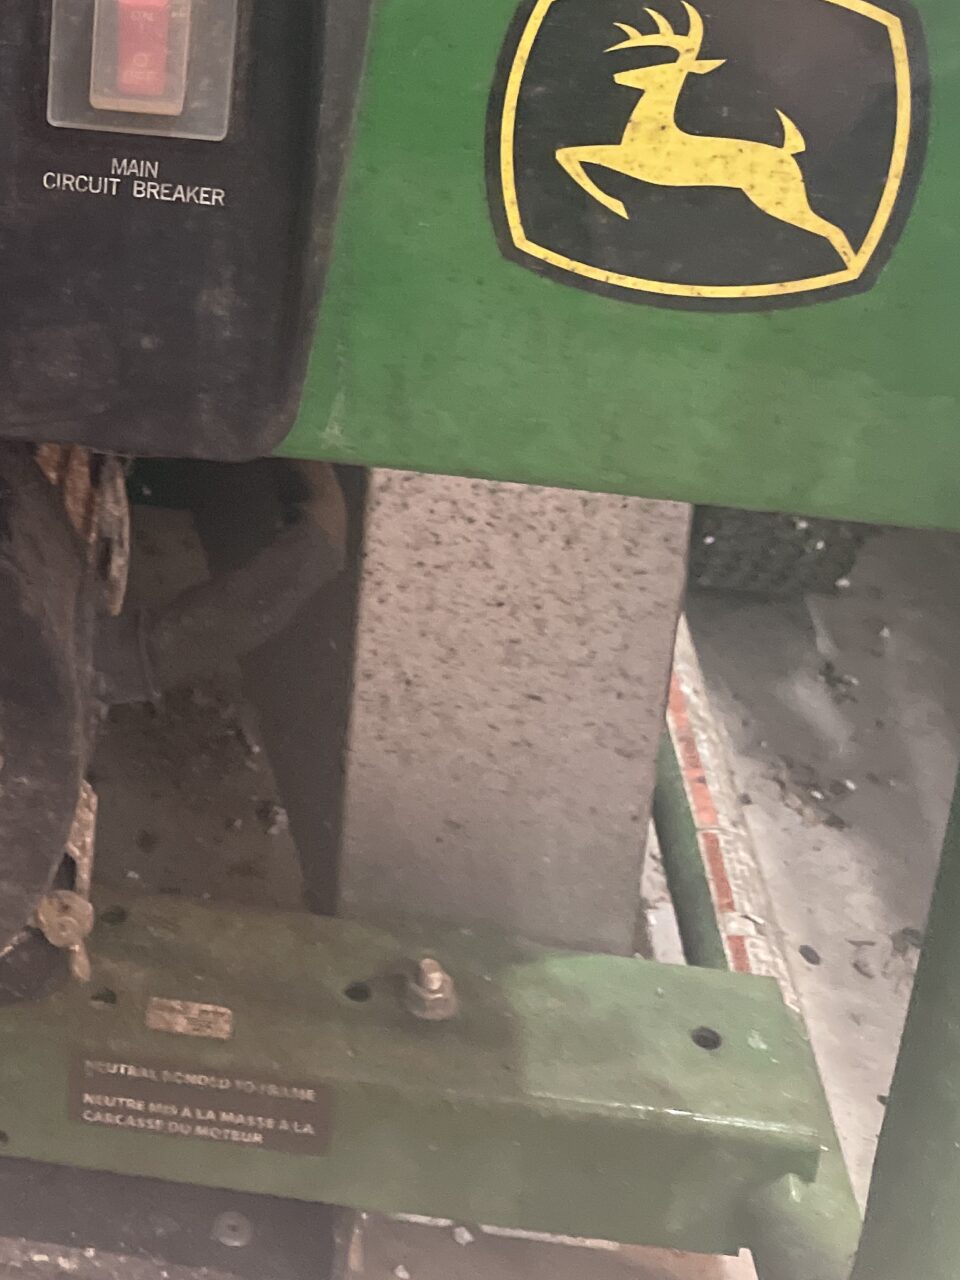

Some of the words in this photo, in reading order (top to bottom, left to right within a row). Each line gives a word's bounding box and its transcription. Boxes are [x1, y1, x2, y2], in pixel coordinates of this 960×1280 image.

[110, 157, 160, 179] MAIN
[42, 171, 122, 196] CIRCUIT
[132, 180, 226, 207] BREAKER
[82, 1092, 145, 1112] NEUTRE
[195, 1108, 217, 1122] LA
[219, 1110, 276, 1129] MASSE
[293, 1121, 316, 1136] LA
[82, 1109, 164, 1131] CARCASSE
[168, 1121, 193, 1136] DU
[194, 1125, 265, 1145] MOTEUR
